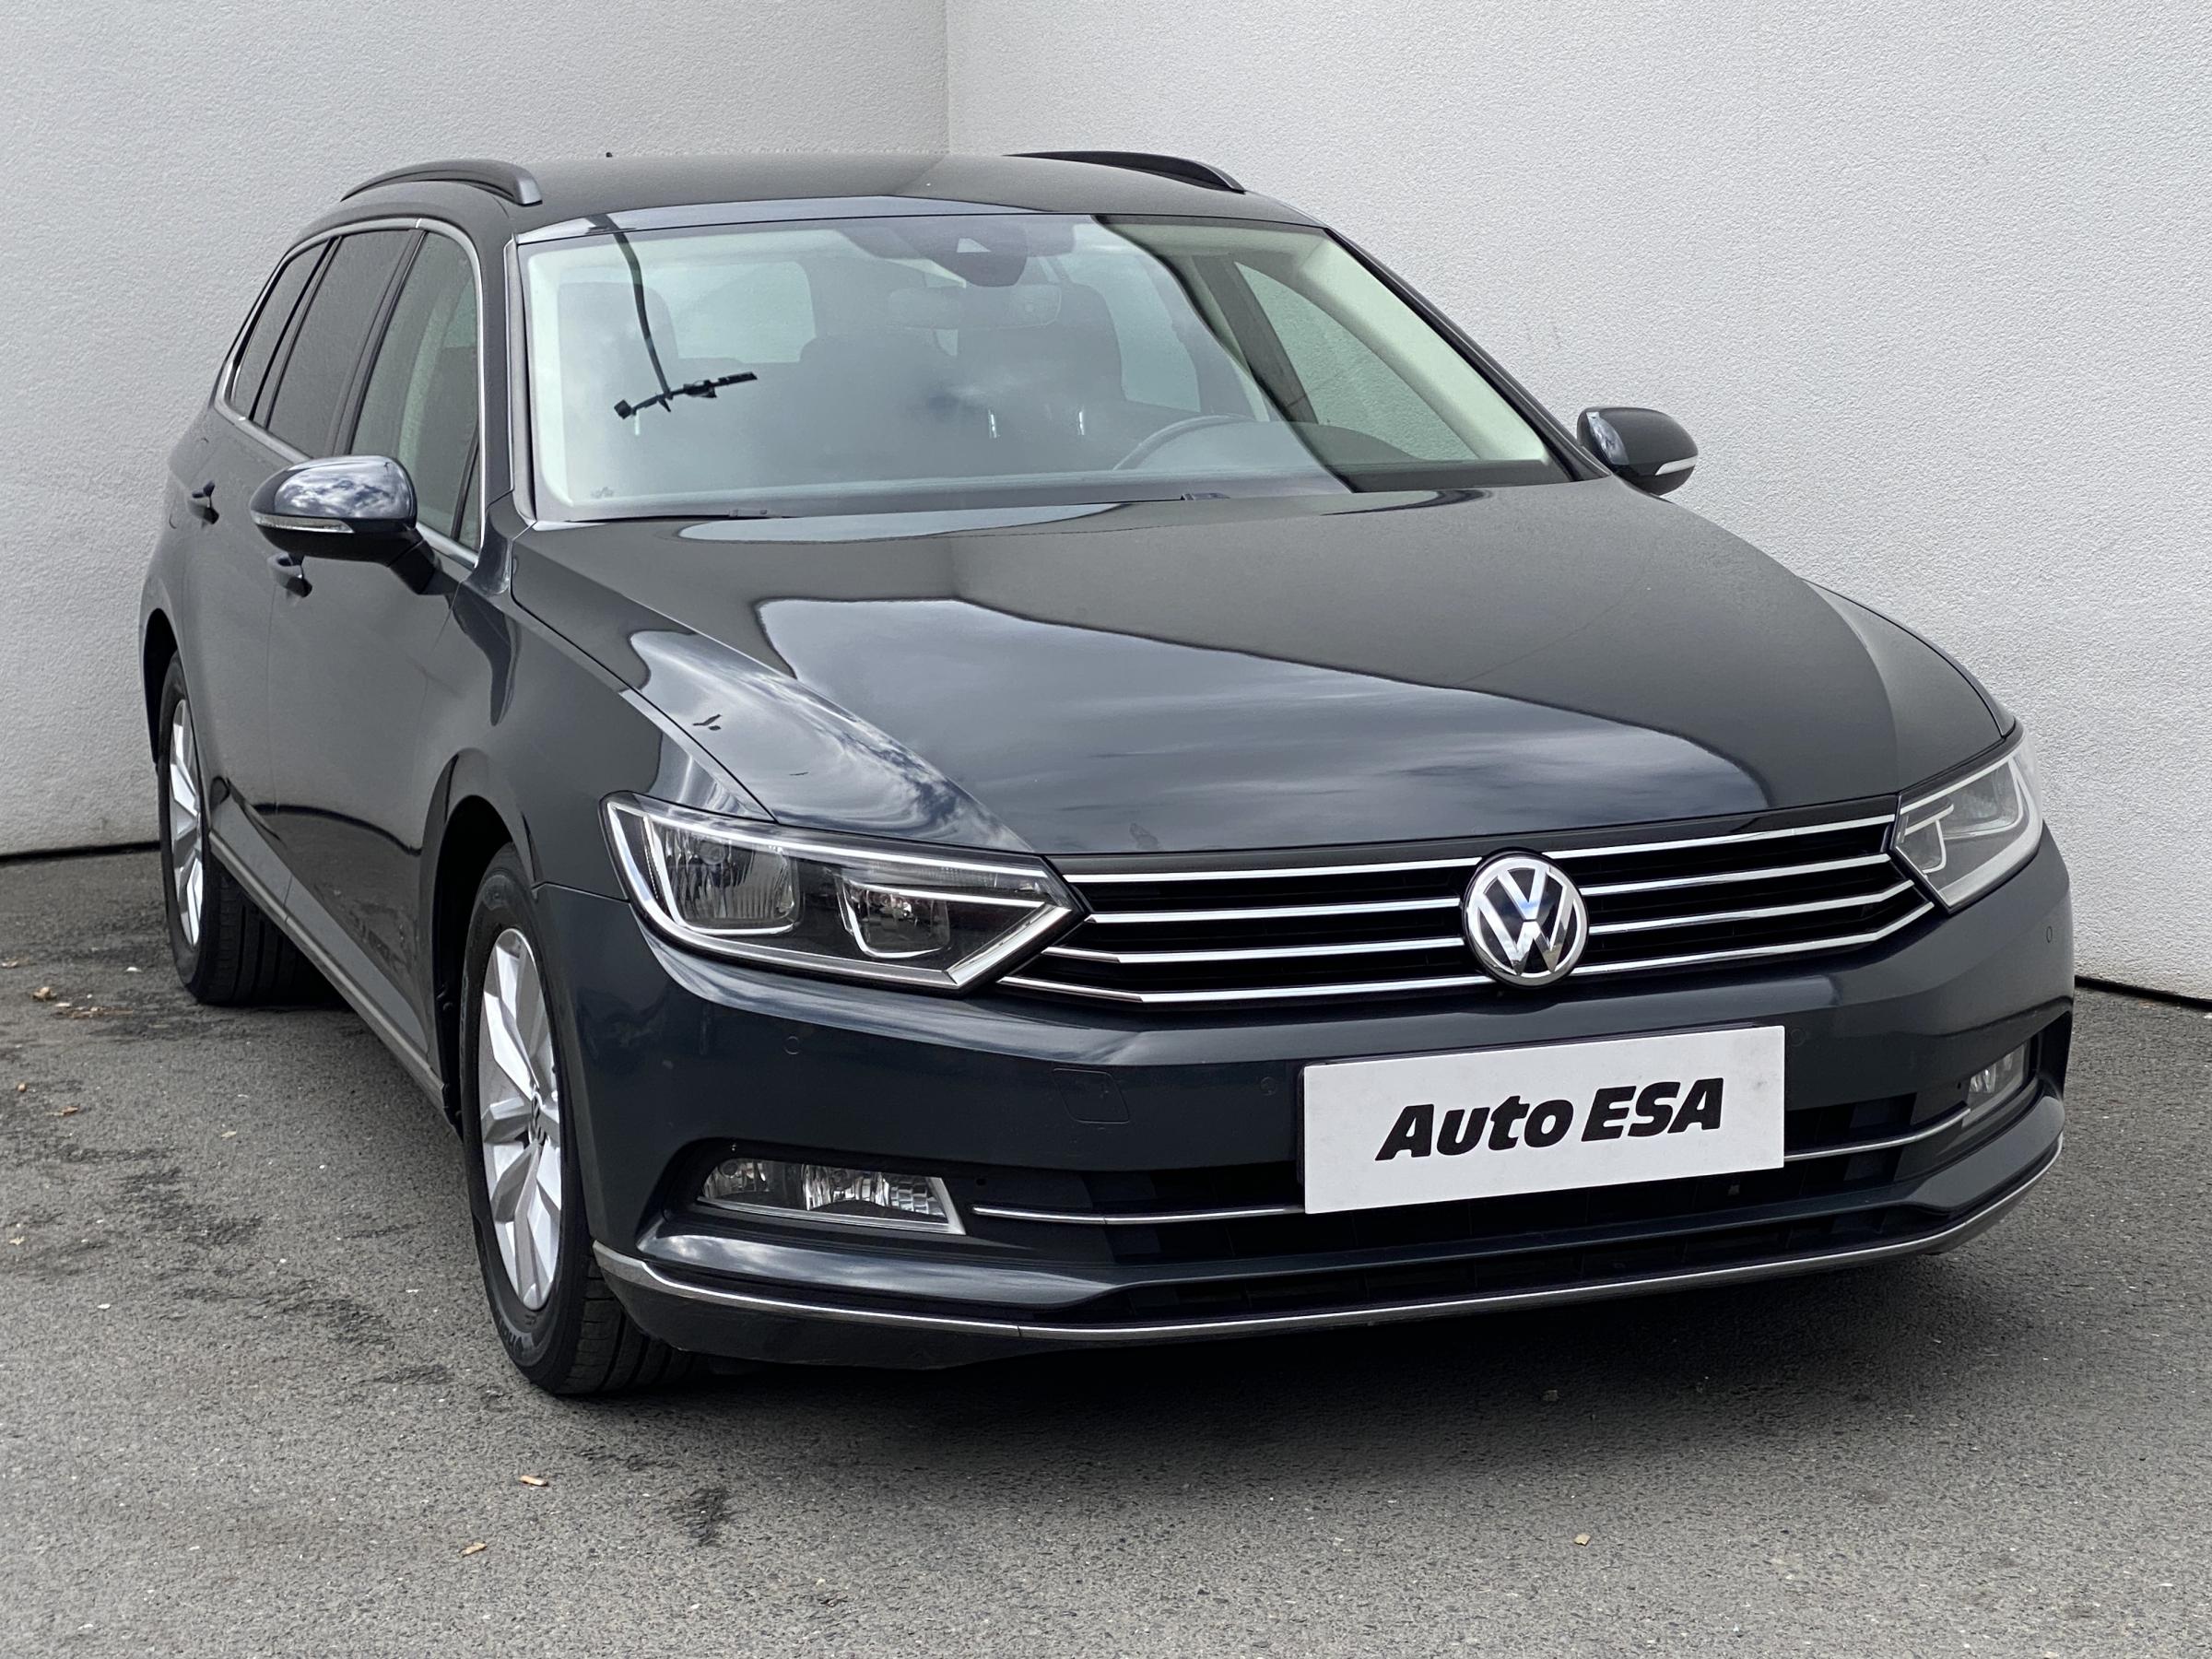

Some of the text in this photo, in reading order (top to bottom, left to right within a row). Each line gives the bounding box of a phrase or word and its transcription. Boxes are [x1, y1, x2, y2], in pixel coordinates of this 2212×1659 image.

[1469, 858, 1585, 983] VW
[1374, 1077, 1724, 1161] Auto ESA
